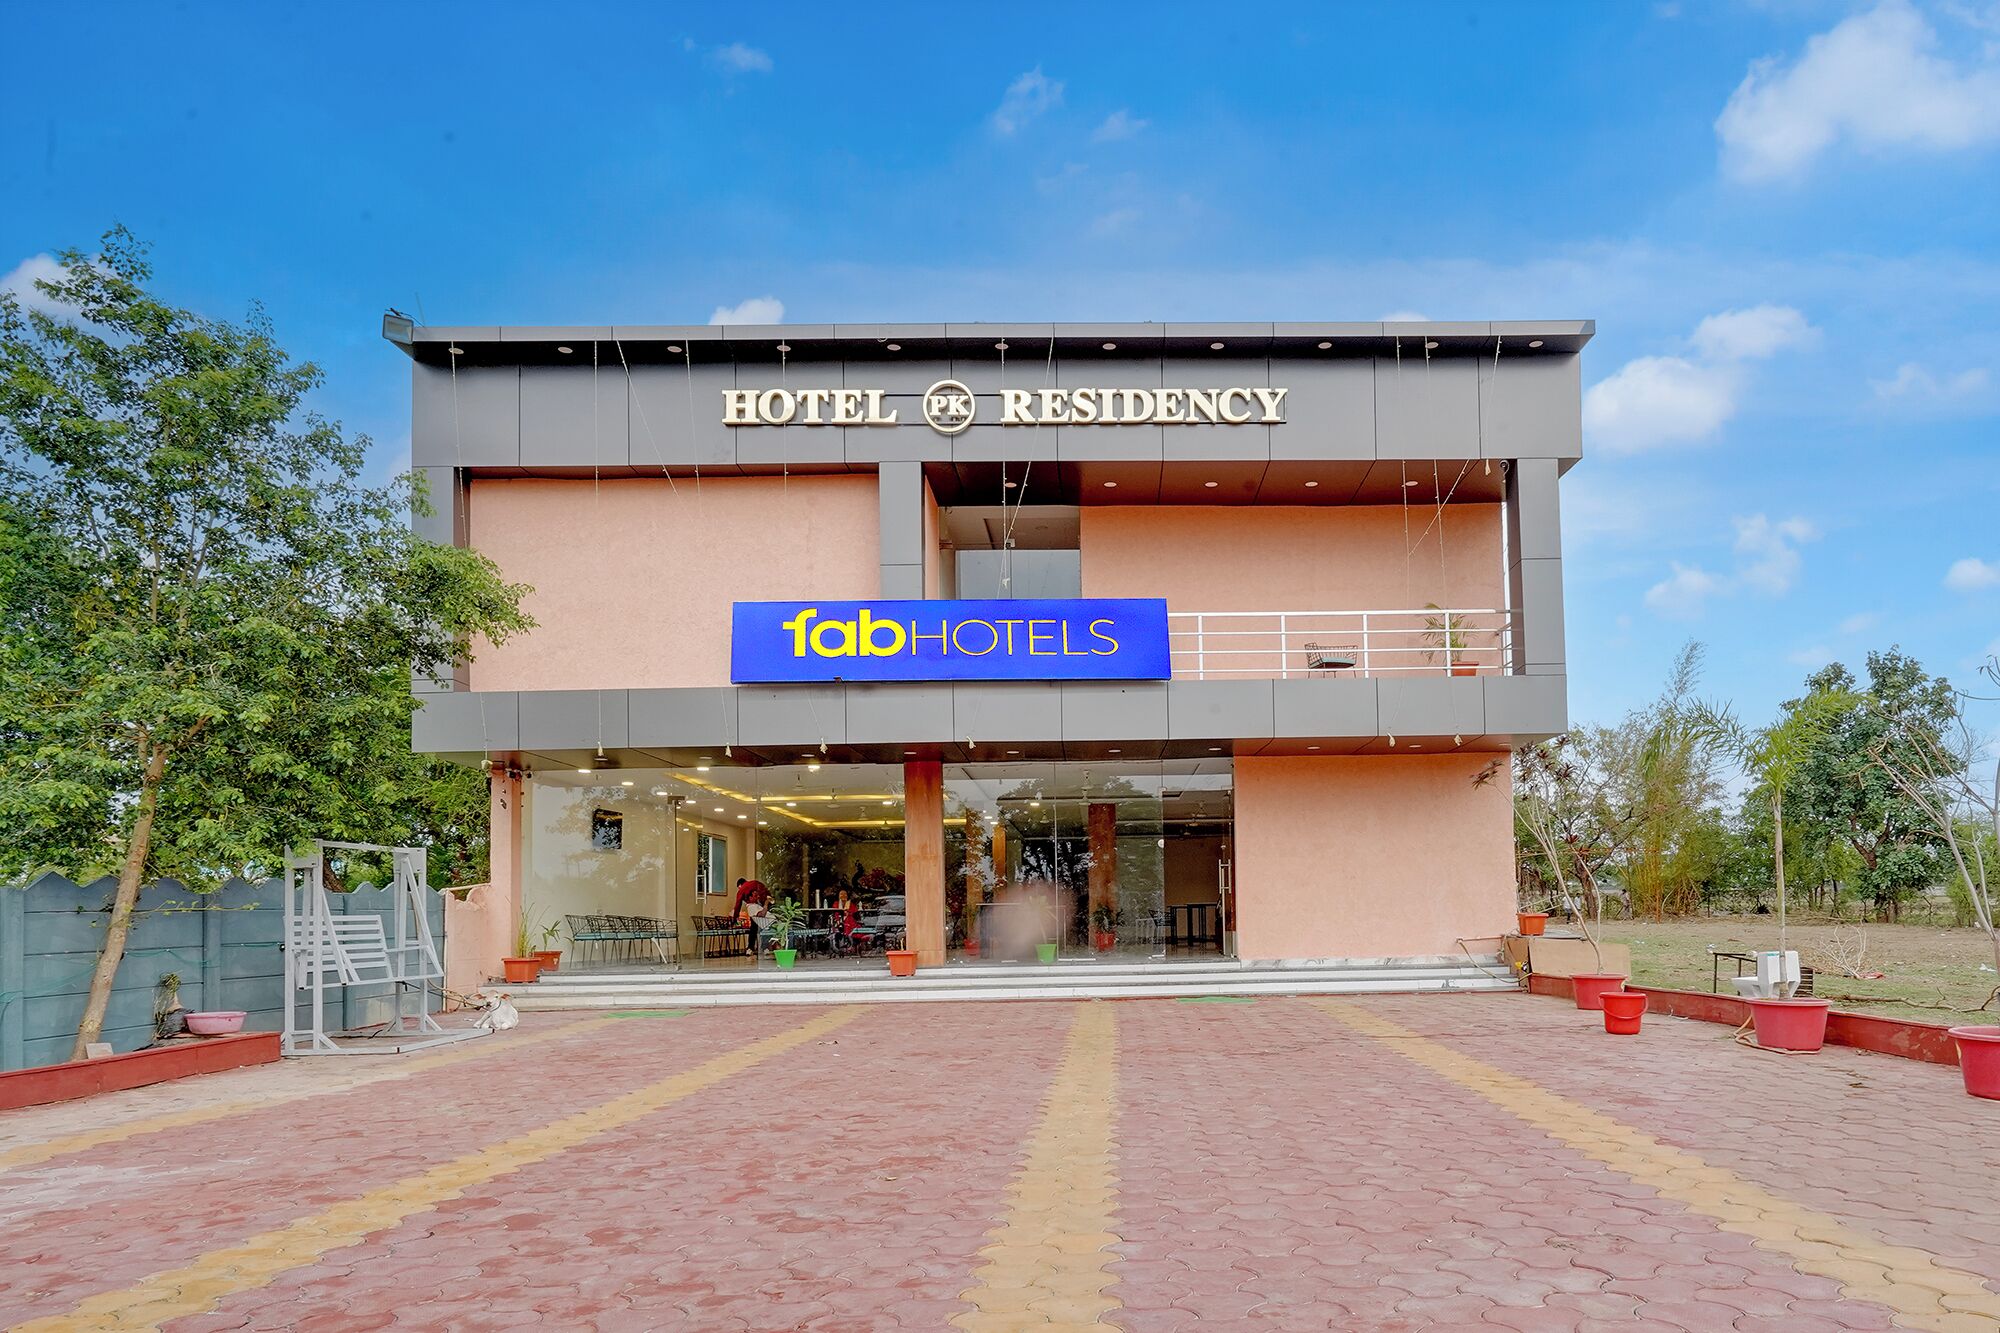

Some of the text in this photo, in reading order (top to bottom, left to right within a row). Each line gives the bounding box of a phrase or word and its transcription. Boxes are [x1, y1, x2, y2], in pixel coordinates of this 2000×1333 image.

[722, 387, 1288, 425] HOTEL PK RESIDENCY
